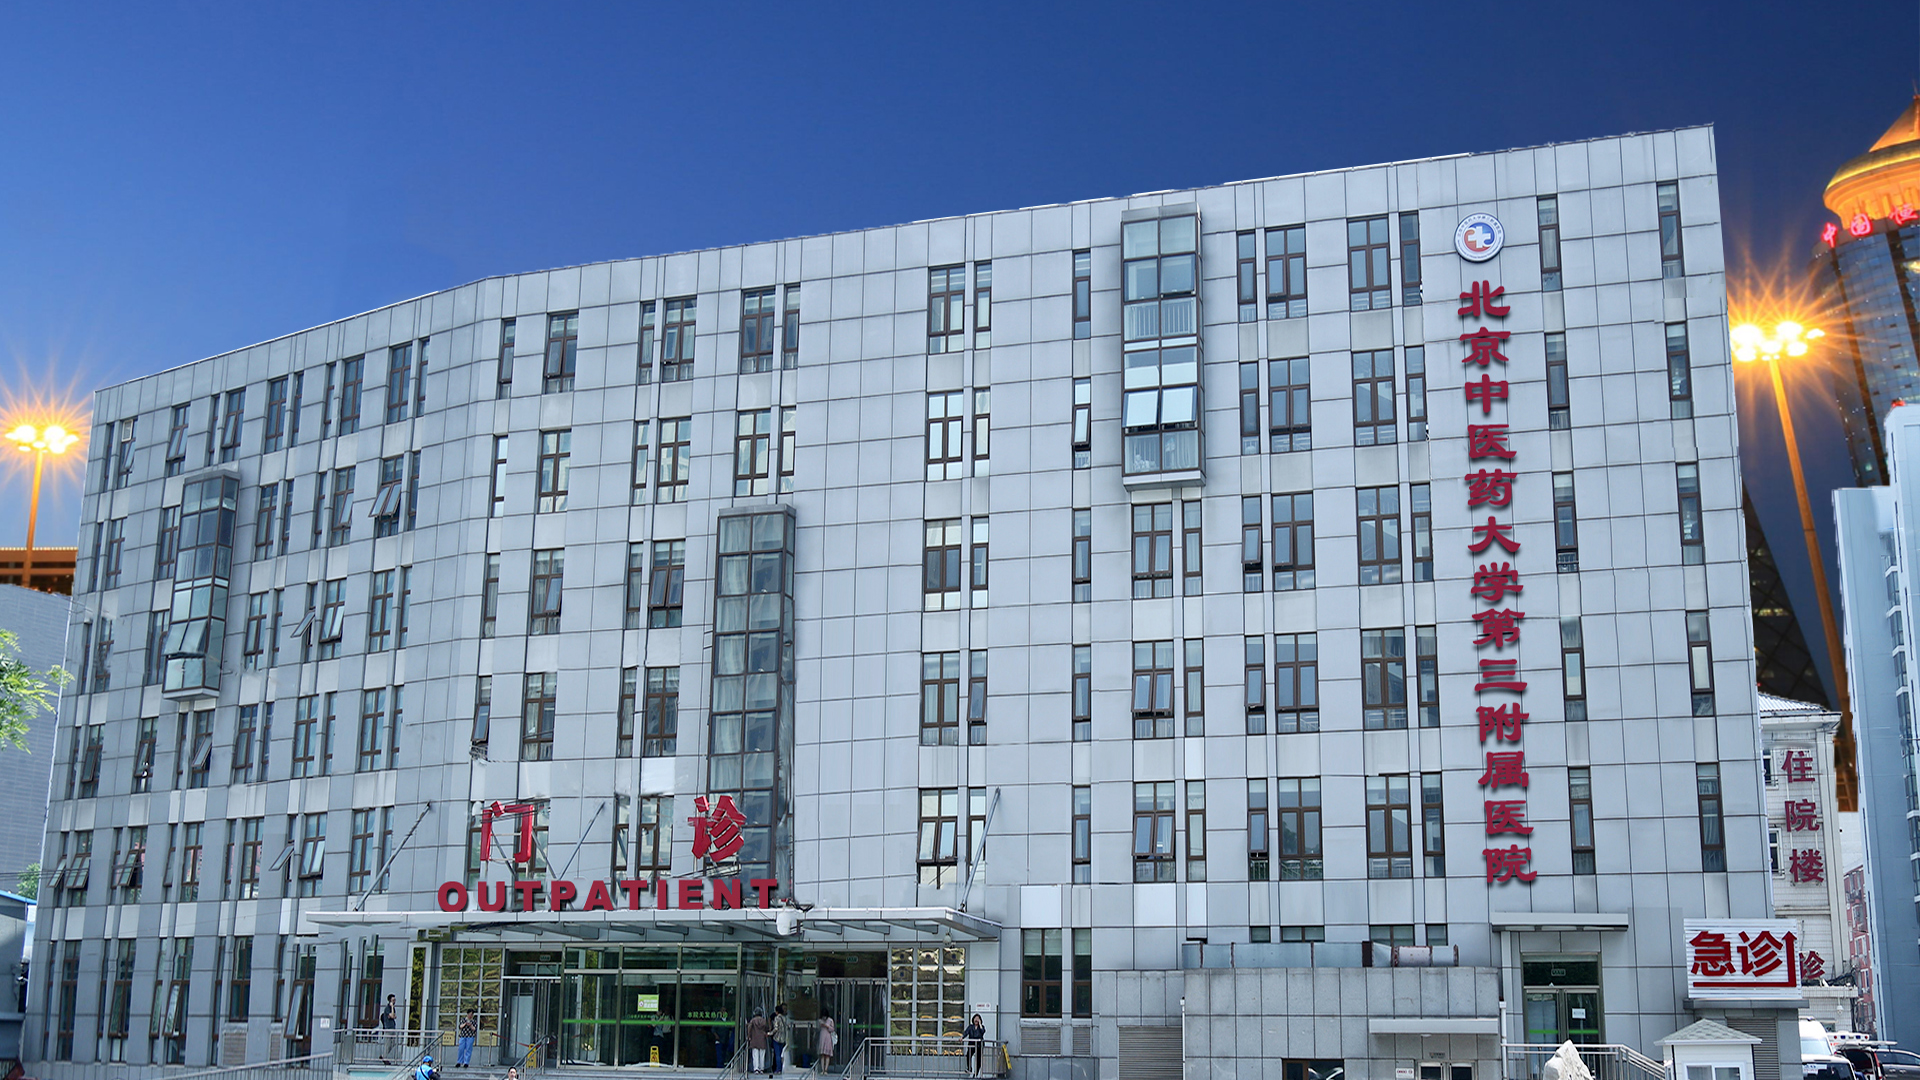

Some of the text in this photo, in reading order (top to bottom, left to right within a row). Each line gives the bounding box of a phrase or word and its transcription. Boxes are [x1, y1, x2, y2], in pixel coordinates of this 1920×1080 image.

[1458, 280, 1538, 883] 北京中医药大学第三附属医院
[480, 795, 748, 863] 门诊
[1781, 750, 1825, 883] 住院楼
[437, 878, 778, 912] OUTPATIENT
[1689, 930, 1784, 977] 急诊
